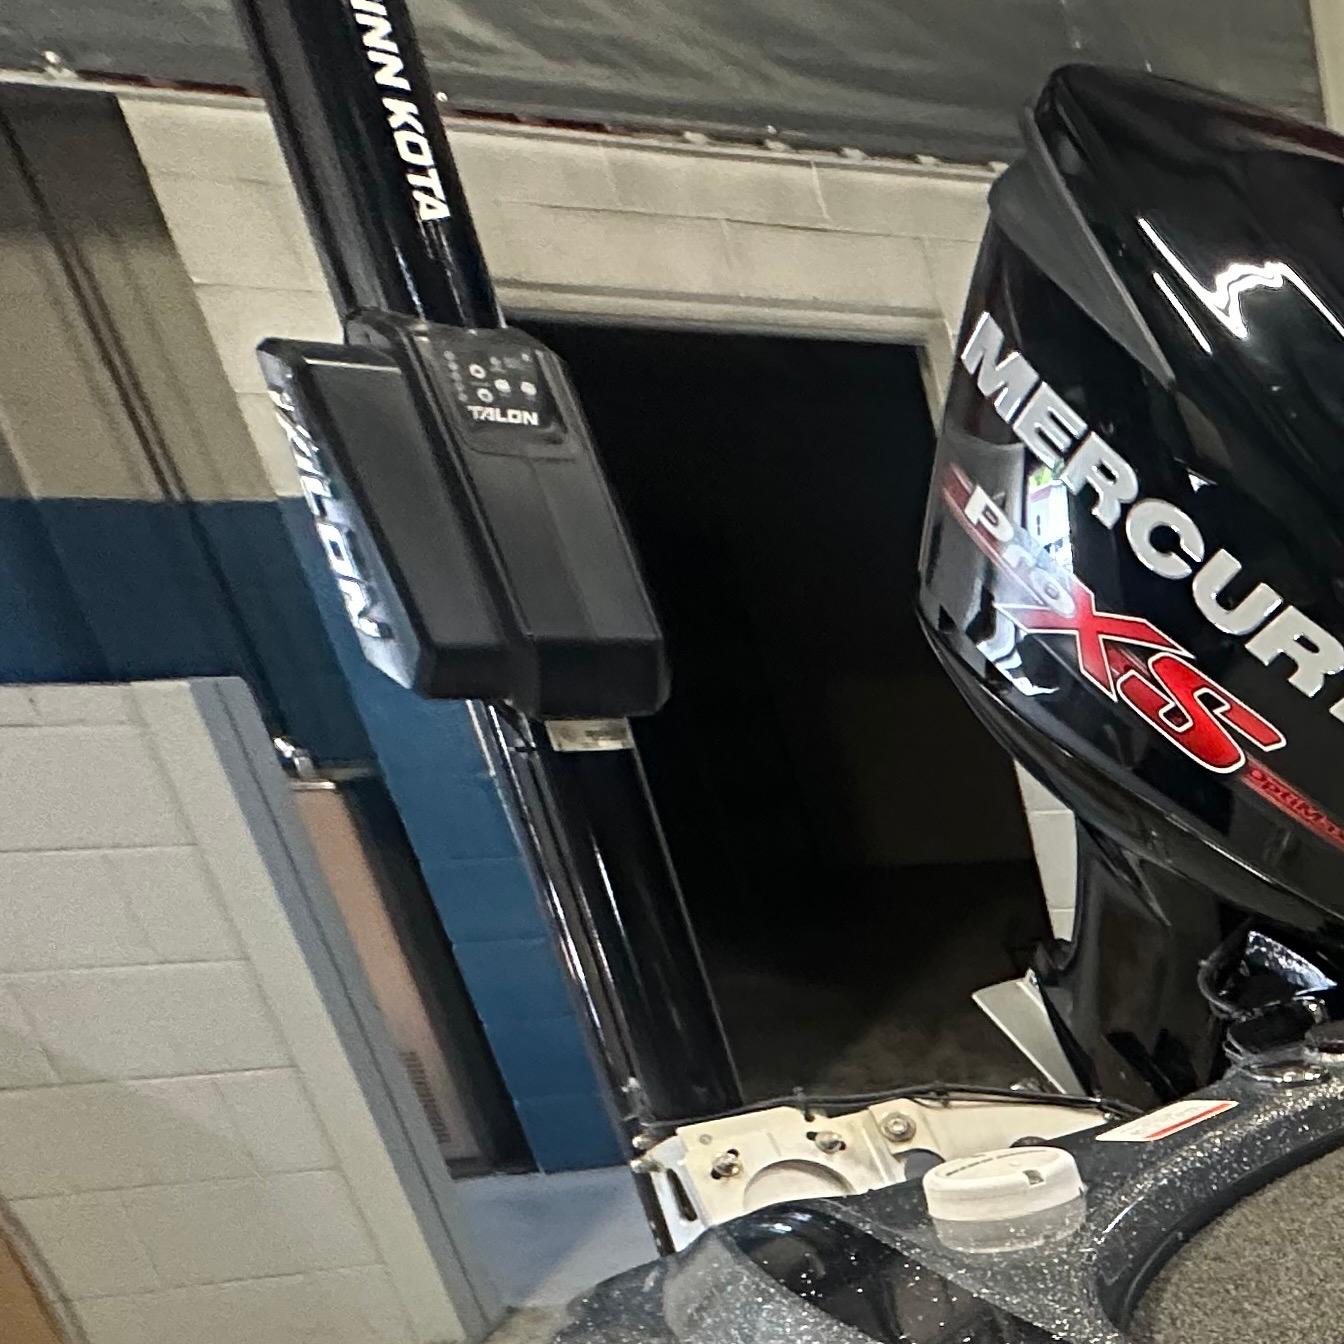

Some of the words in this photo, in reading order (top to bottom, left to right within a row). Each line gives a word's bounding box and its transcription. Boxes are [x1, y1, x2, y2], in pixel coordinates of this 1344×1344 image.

[351, 0, 411, 91] INN
[382, 97, 450, 221] KOTA
[466, 405, 540, 426] TALON
